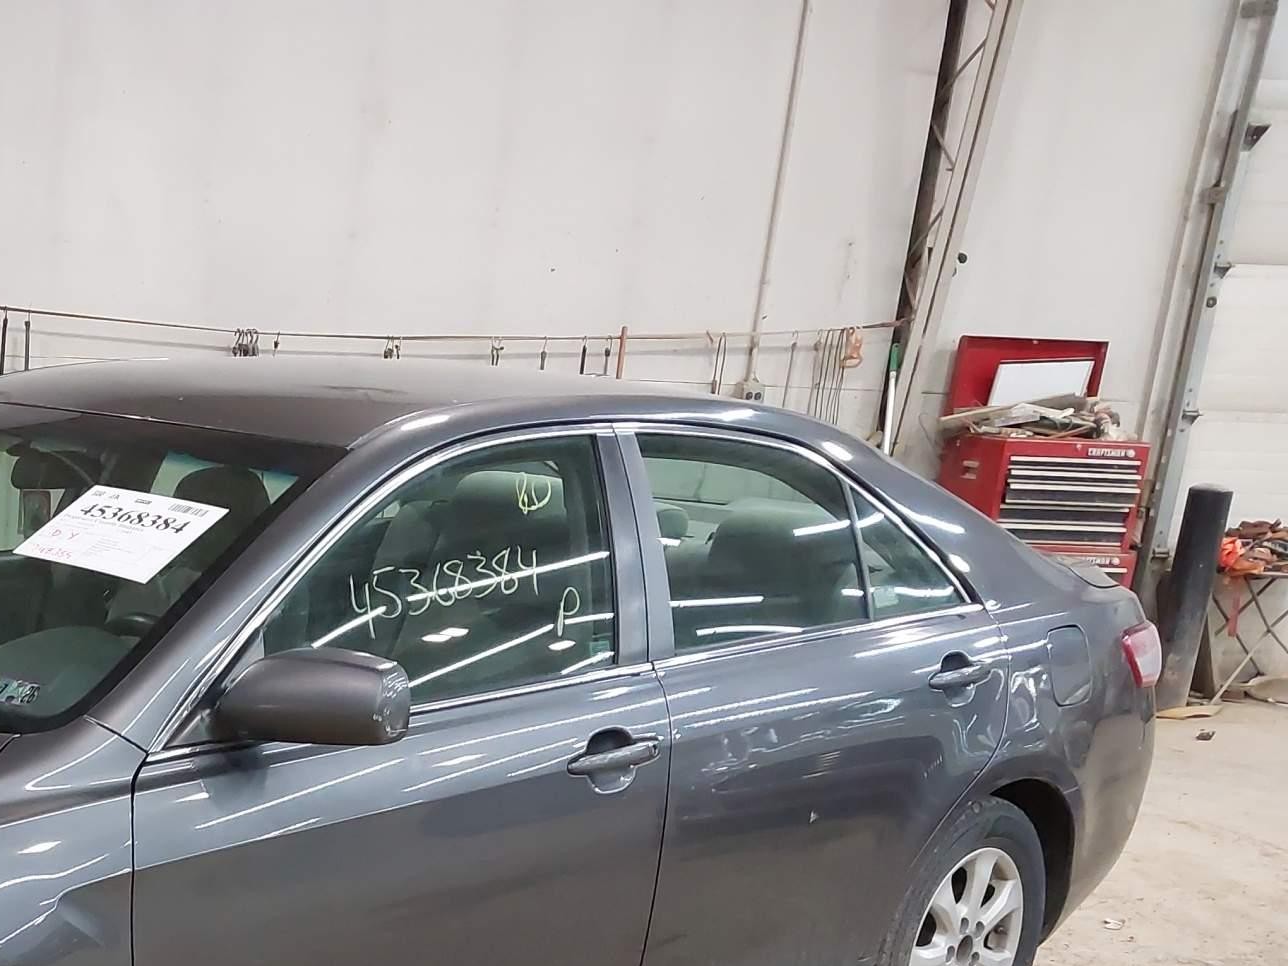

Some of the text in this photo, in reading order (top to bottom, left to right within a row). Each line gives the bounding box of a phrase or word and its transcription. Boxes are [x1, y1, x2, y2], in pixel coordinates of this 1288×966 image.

[1088, 447, 1126, 457] CRAFTSMAN
[79, 502, 191, 535] 45368384
[349, 545, 539, 640] 45368384
